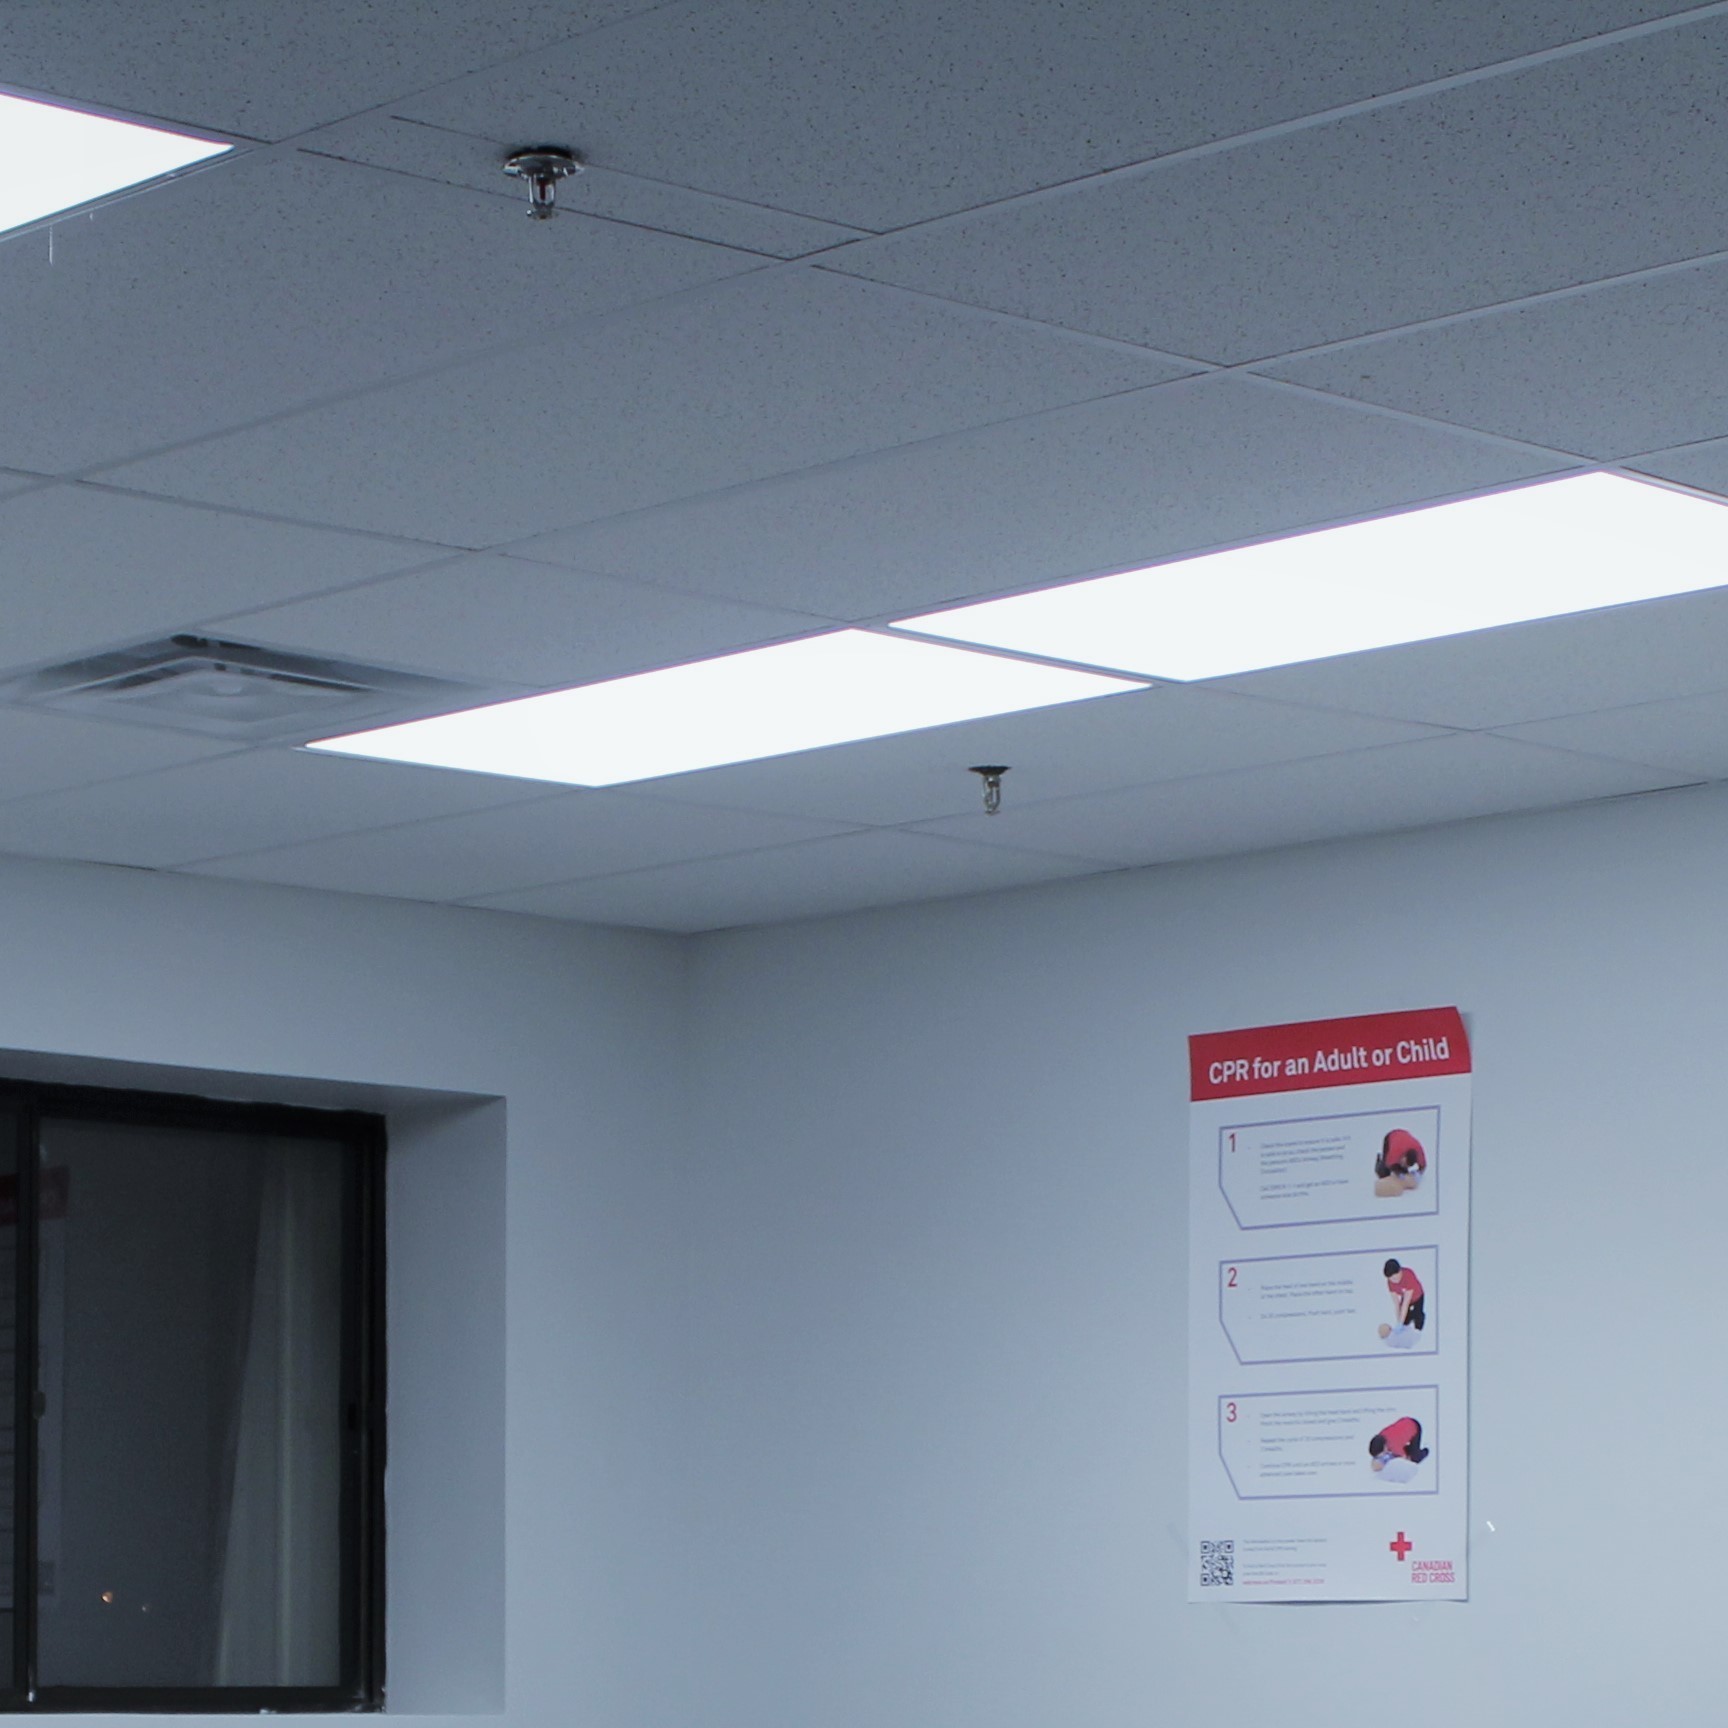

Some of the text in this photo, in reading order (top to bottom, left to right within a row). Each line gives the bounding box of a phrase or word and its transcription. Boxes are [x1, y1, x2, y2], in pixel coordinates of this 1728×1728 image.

[1209, 1037, 1450, 1084] CPR for an Adult or Child
[1228, 1132, 1237, 1152] 1
[1227, 1267, 1238, 1288] 2
[1226, 1402, 1238, 1423] 3
[1412, 1560, 1453, 1572] CANADIAN
[1411, 1571, 1456, 1583] RED CROSS
